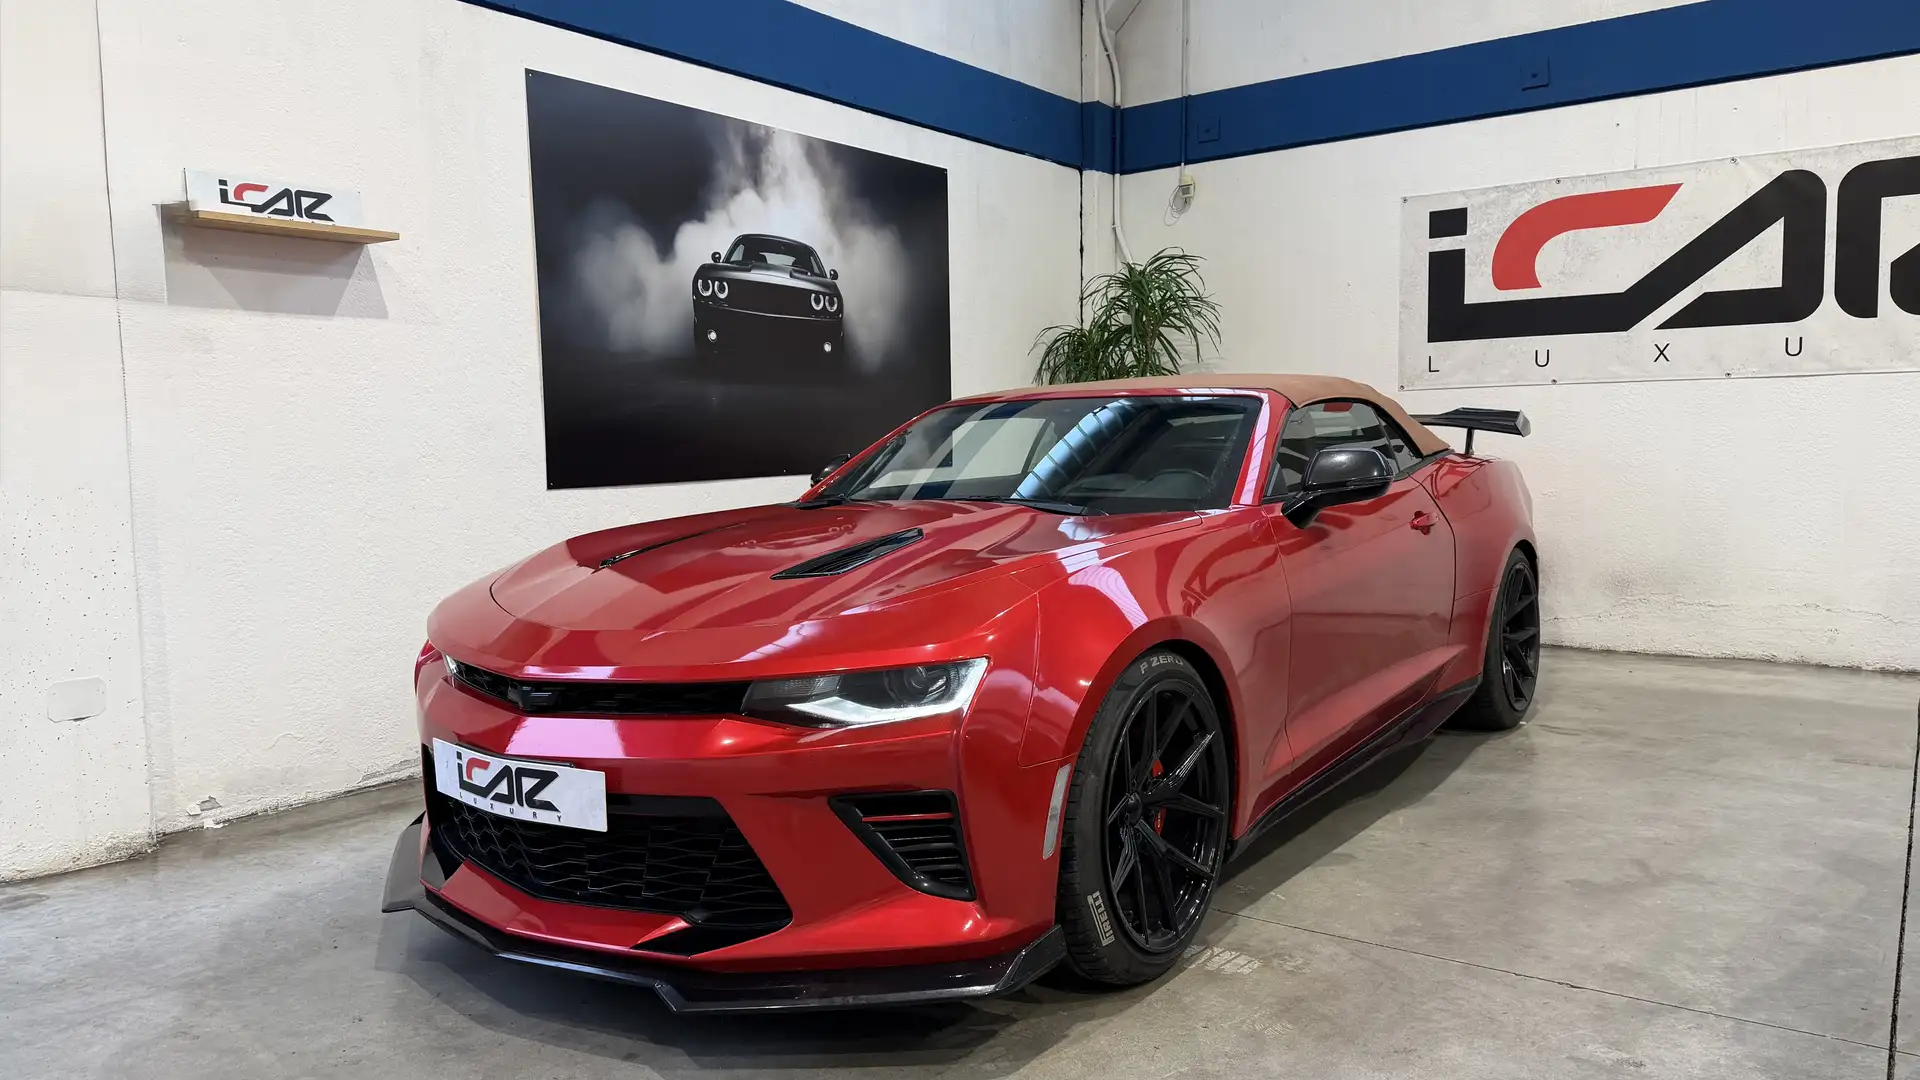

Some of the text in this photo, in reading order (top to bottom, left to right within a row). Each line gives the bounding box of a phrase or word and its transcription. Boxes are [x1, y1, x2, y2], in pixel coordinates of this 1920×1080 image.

[1139, 661, 1149, 675] P
[459, 792, 562, 823] LUXURY
[1087, 890, 1116, 947] PIRELLI
